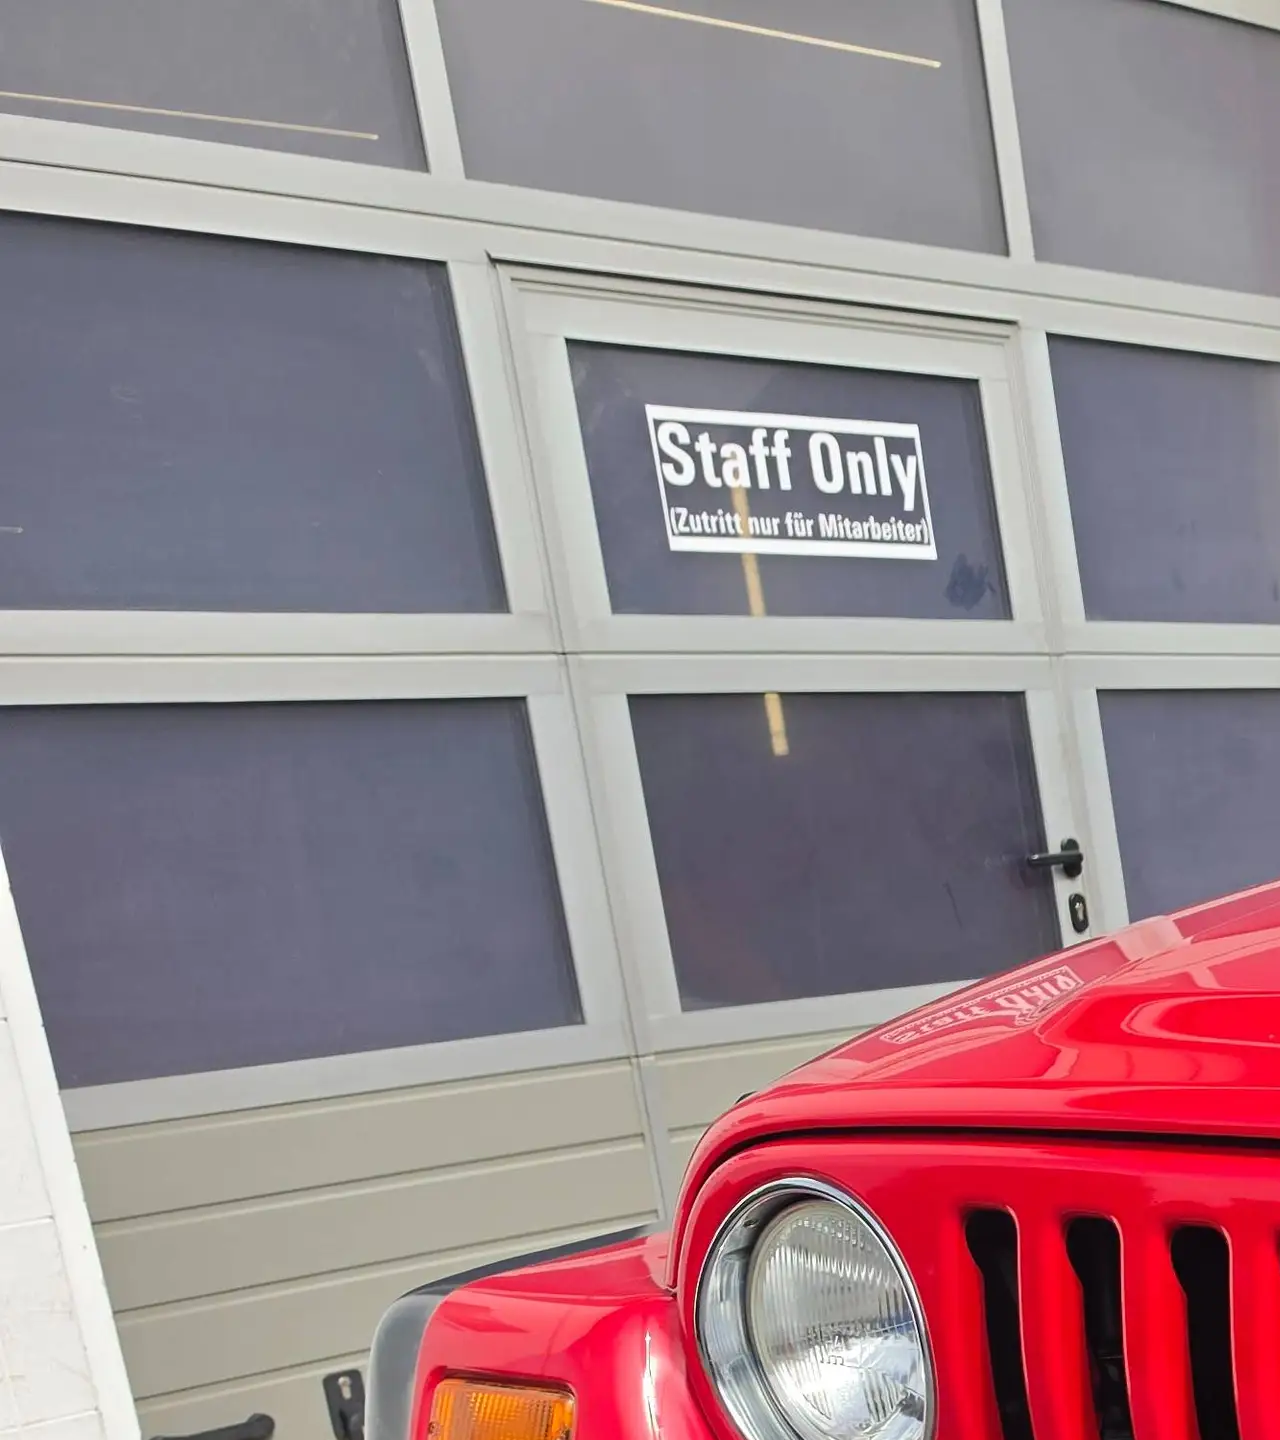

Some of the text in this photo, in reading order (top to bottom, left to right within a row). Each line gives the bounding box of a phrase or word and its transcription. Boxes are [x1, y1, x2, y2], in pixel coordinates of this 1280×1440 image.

[657, 421, 917, 511] Staff Only
[747, 516, 780, 536] nur
[785, 511, 814, 537] für
[819, 513, 930, 544] Mitarbeiter)
